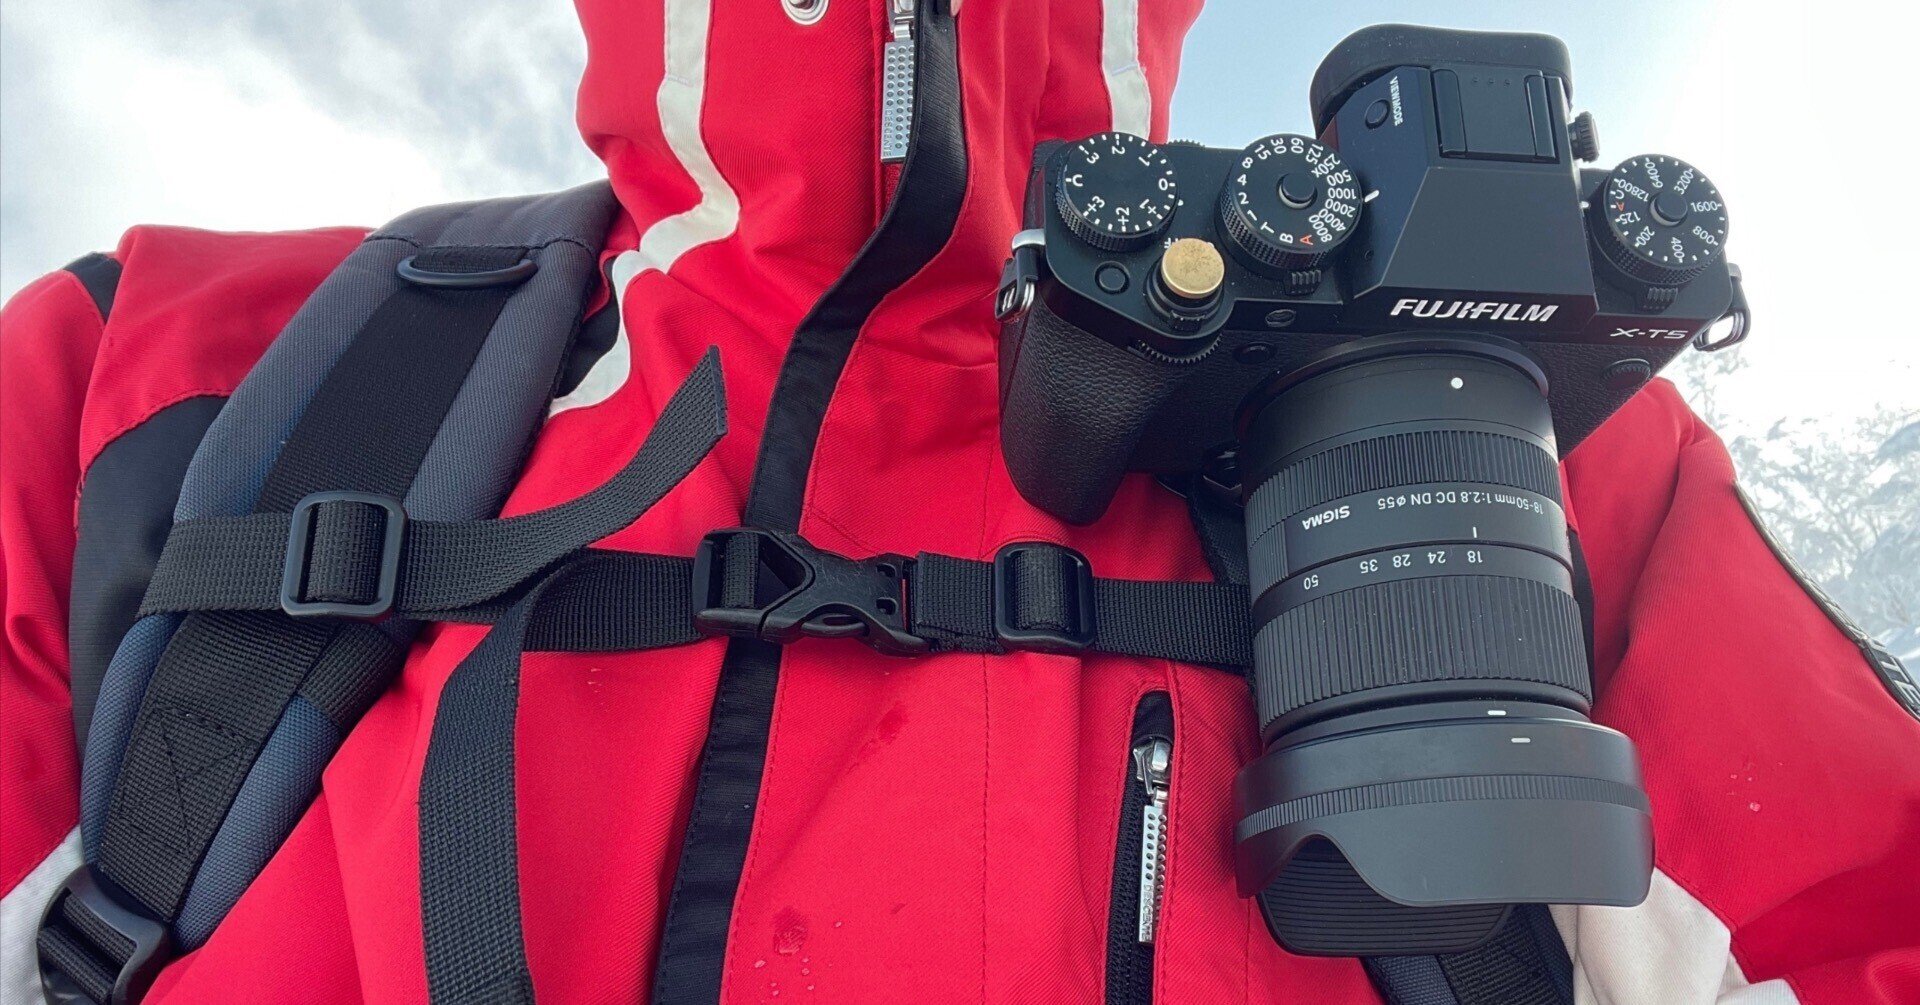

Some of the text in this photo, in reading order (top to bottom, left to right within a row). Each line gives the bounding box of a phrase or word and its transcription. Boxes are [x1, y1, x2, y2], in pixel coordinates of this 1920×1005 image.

[1254, 144, 1272, 160] 15
[1271, 138, 1287, 154] 30
[1291, 138, 1304, 154] 60
[1305, 144, 1324, 165] 125
[1242, 157, 1253, 169] 8
[1072, 174, 1083, 187] C
[1237, 174, 1247, 186] 4
[1326, 170, 1352, 187] 500
[1644, 162, 1664, 188] 6400
[1673, 170, 1694, 195] 3200
[1238, 192, 1249, 205] 2
[1327, 187, 1357, 200] 1000
[1615, 190, 1625, 200] C
[1617, 179, 1650, 202] 12800
[1087, 195, 1105, 212] +3
[1139, 199, 1156, 214] +1
[1325, 199, 1356, 218] 2000
[1615, 201, 1625, 212] A
[1690, 201, 1718, 212] 1600
[1115, 207, 1130, 225] +2
[1247, 210, 1258, 221] 1
[1318, 209, 1346, 232] 4000
[1619, 211, 1641, 225] 125
[1260, 221, 1275, 234] T
[1308, 215, 1333, 243] 8000
[1692, 226, 1715, 245] 800
[1279, 232, 1294, 244] B
[1300, 234, 1314, 246] A
[1636, 226, 1655, 246] 200
[1671, 237, 1685, 259] 400
[1390, 298, 1559, 322] FUJIFILM
[1609, 327, 1689, 340] X-T5
[1411, 492, 1432, 506] DN
[1436, 491, 1456, 504] DC
[1460, 491, 1492, 504] 1:2.8
[1494, 493, 1543, 515] 18-50mm
[1302, 505, 1351, 530] SIGMA
[1303, 550, 1483, 590] 18 24 28 35 50
